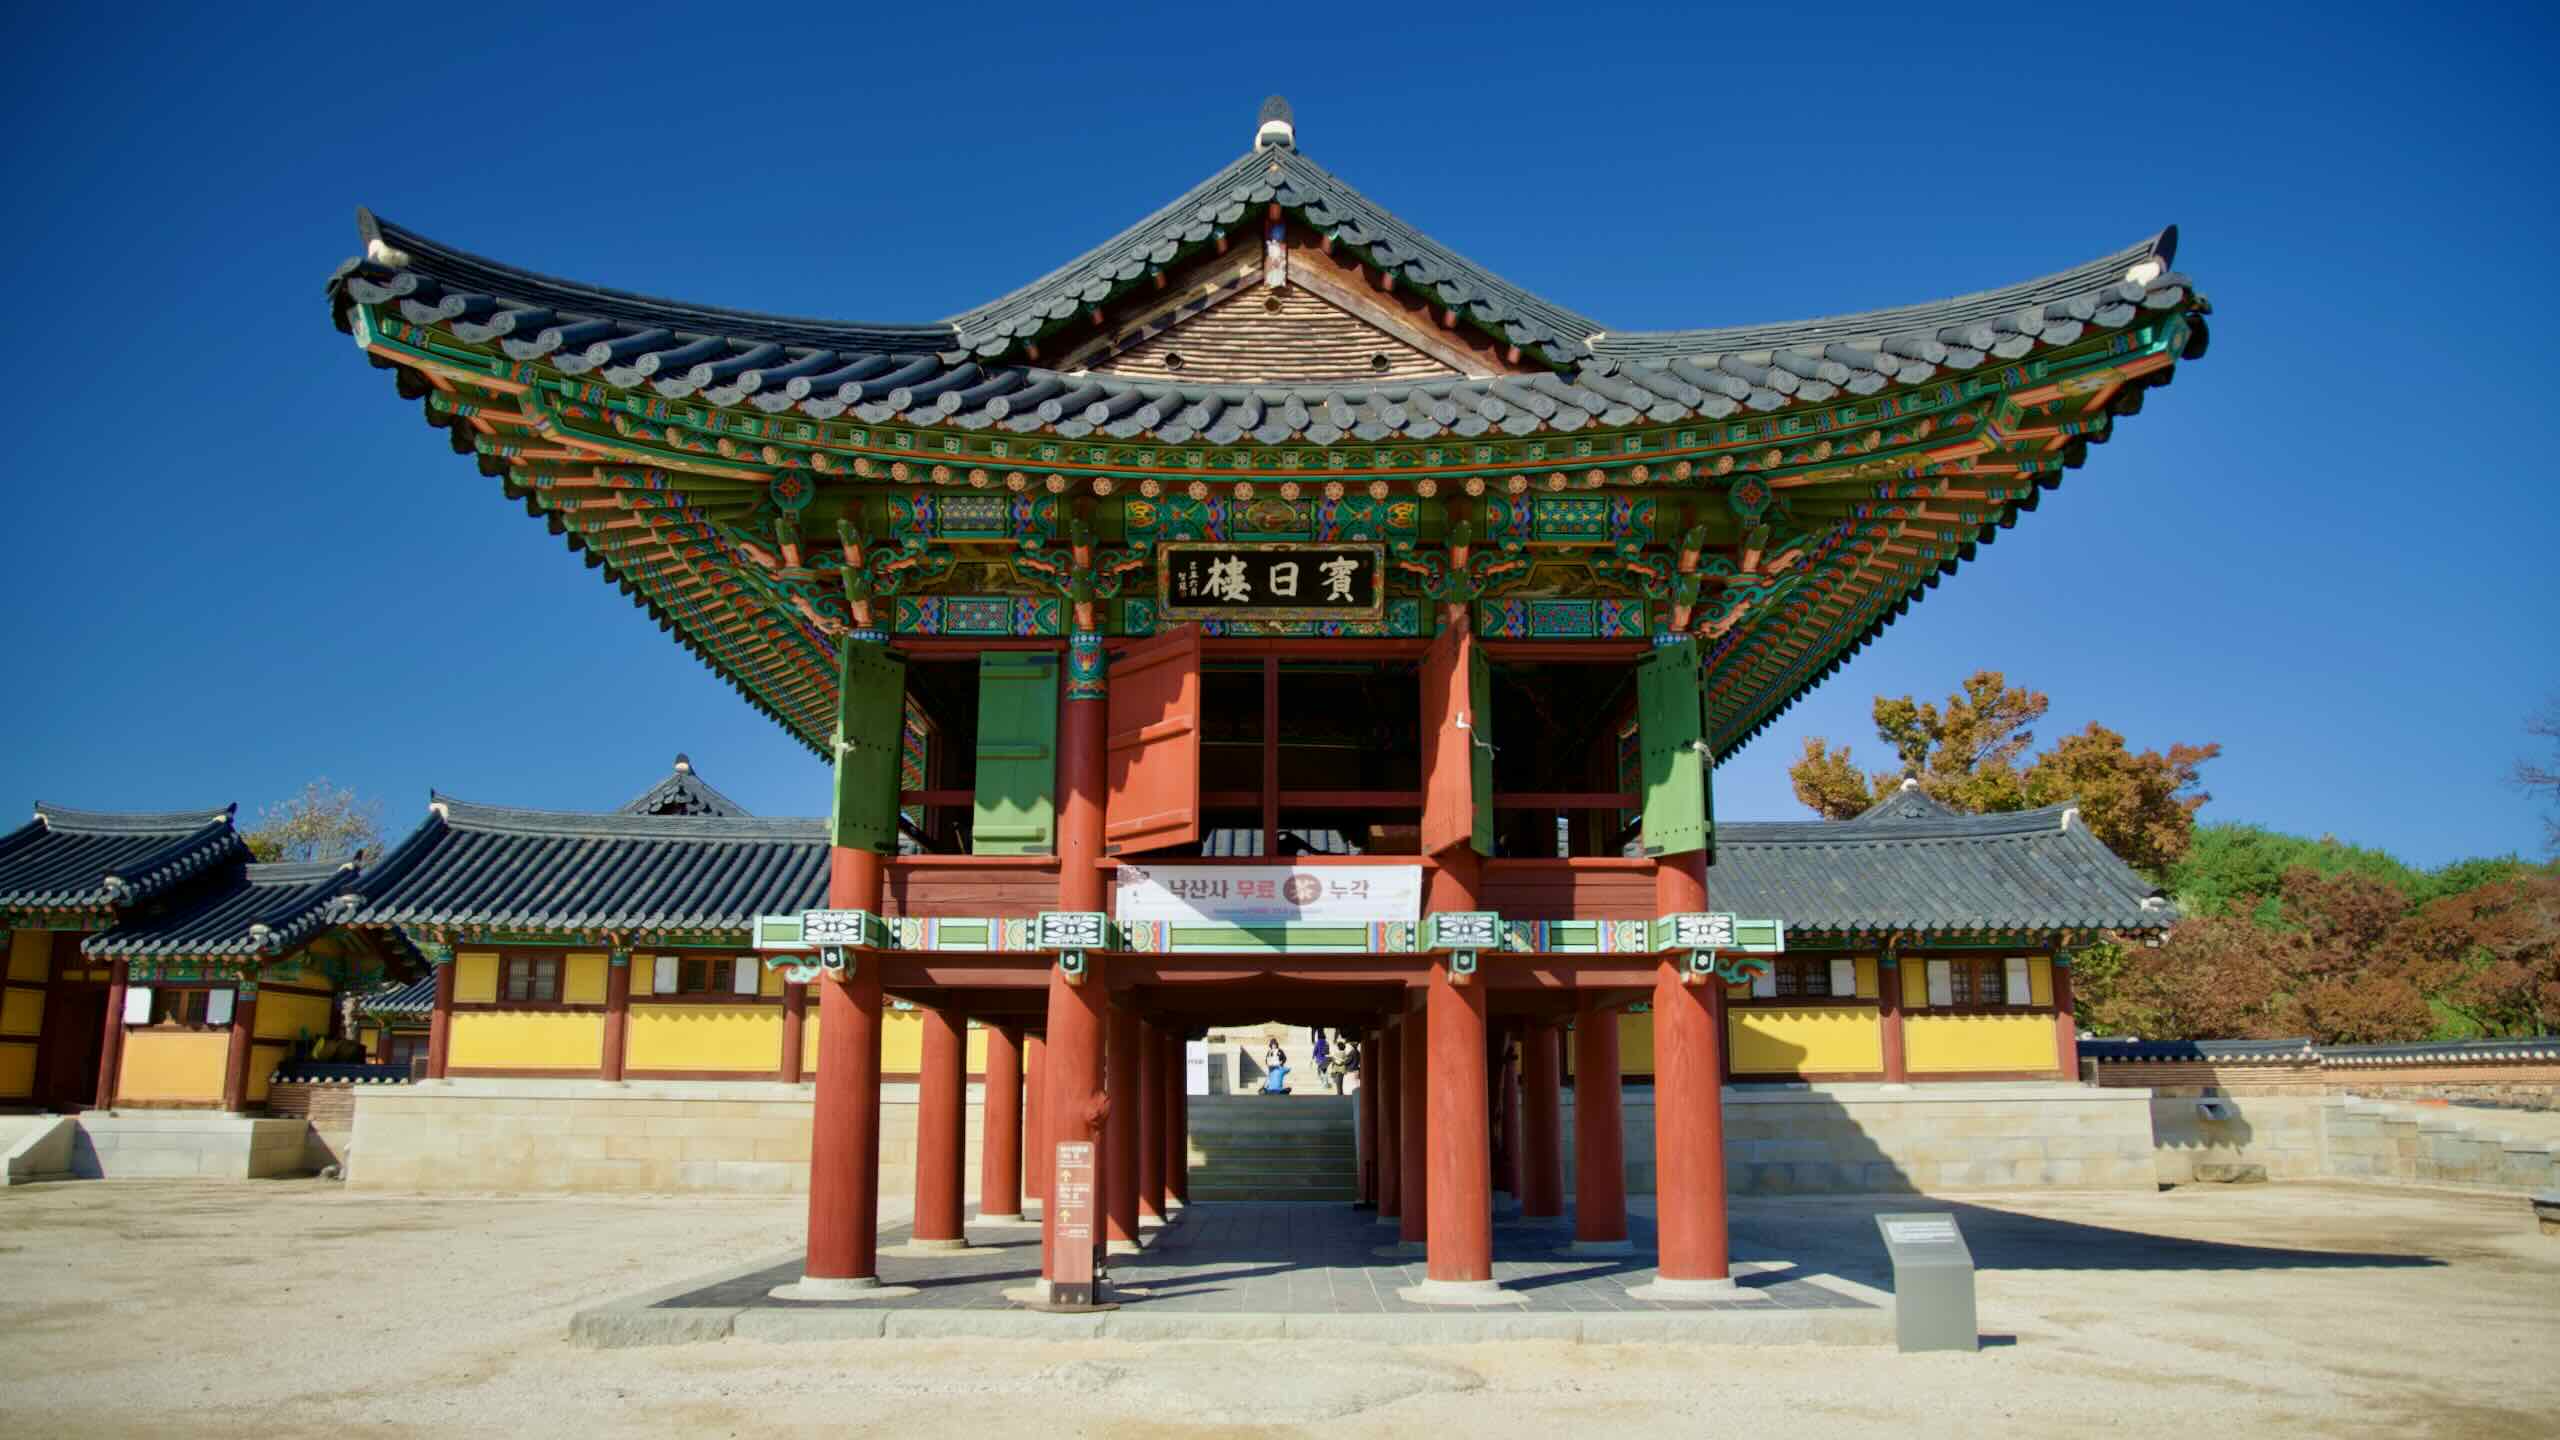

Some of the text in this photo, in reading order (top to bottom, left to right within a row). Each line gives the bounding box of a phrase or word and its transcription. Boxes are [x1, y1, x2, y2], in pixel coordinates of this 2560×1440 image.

[1169, 879, 1229, 899] 낙산사
[1237, 880, 1276, 899] 무료
[1329, 879, 1369, 900] 누각
